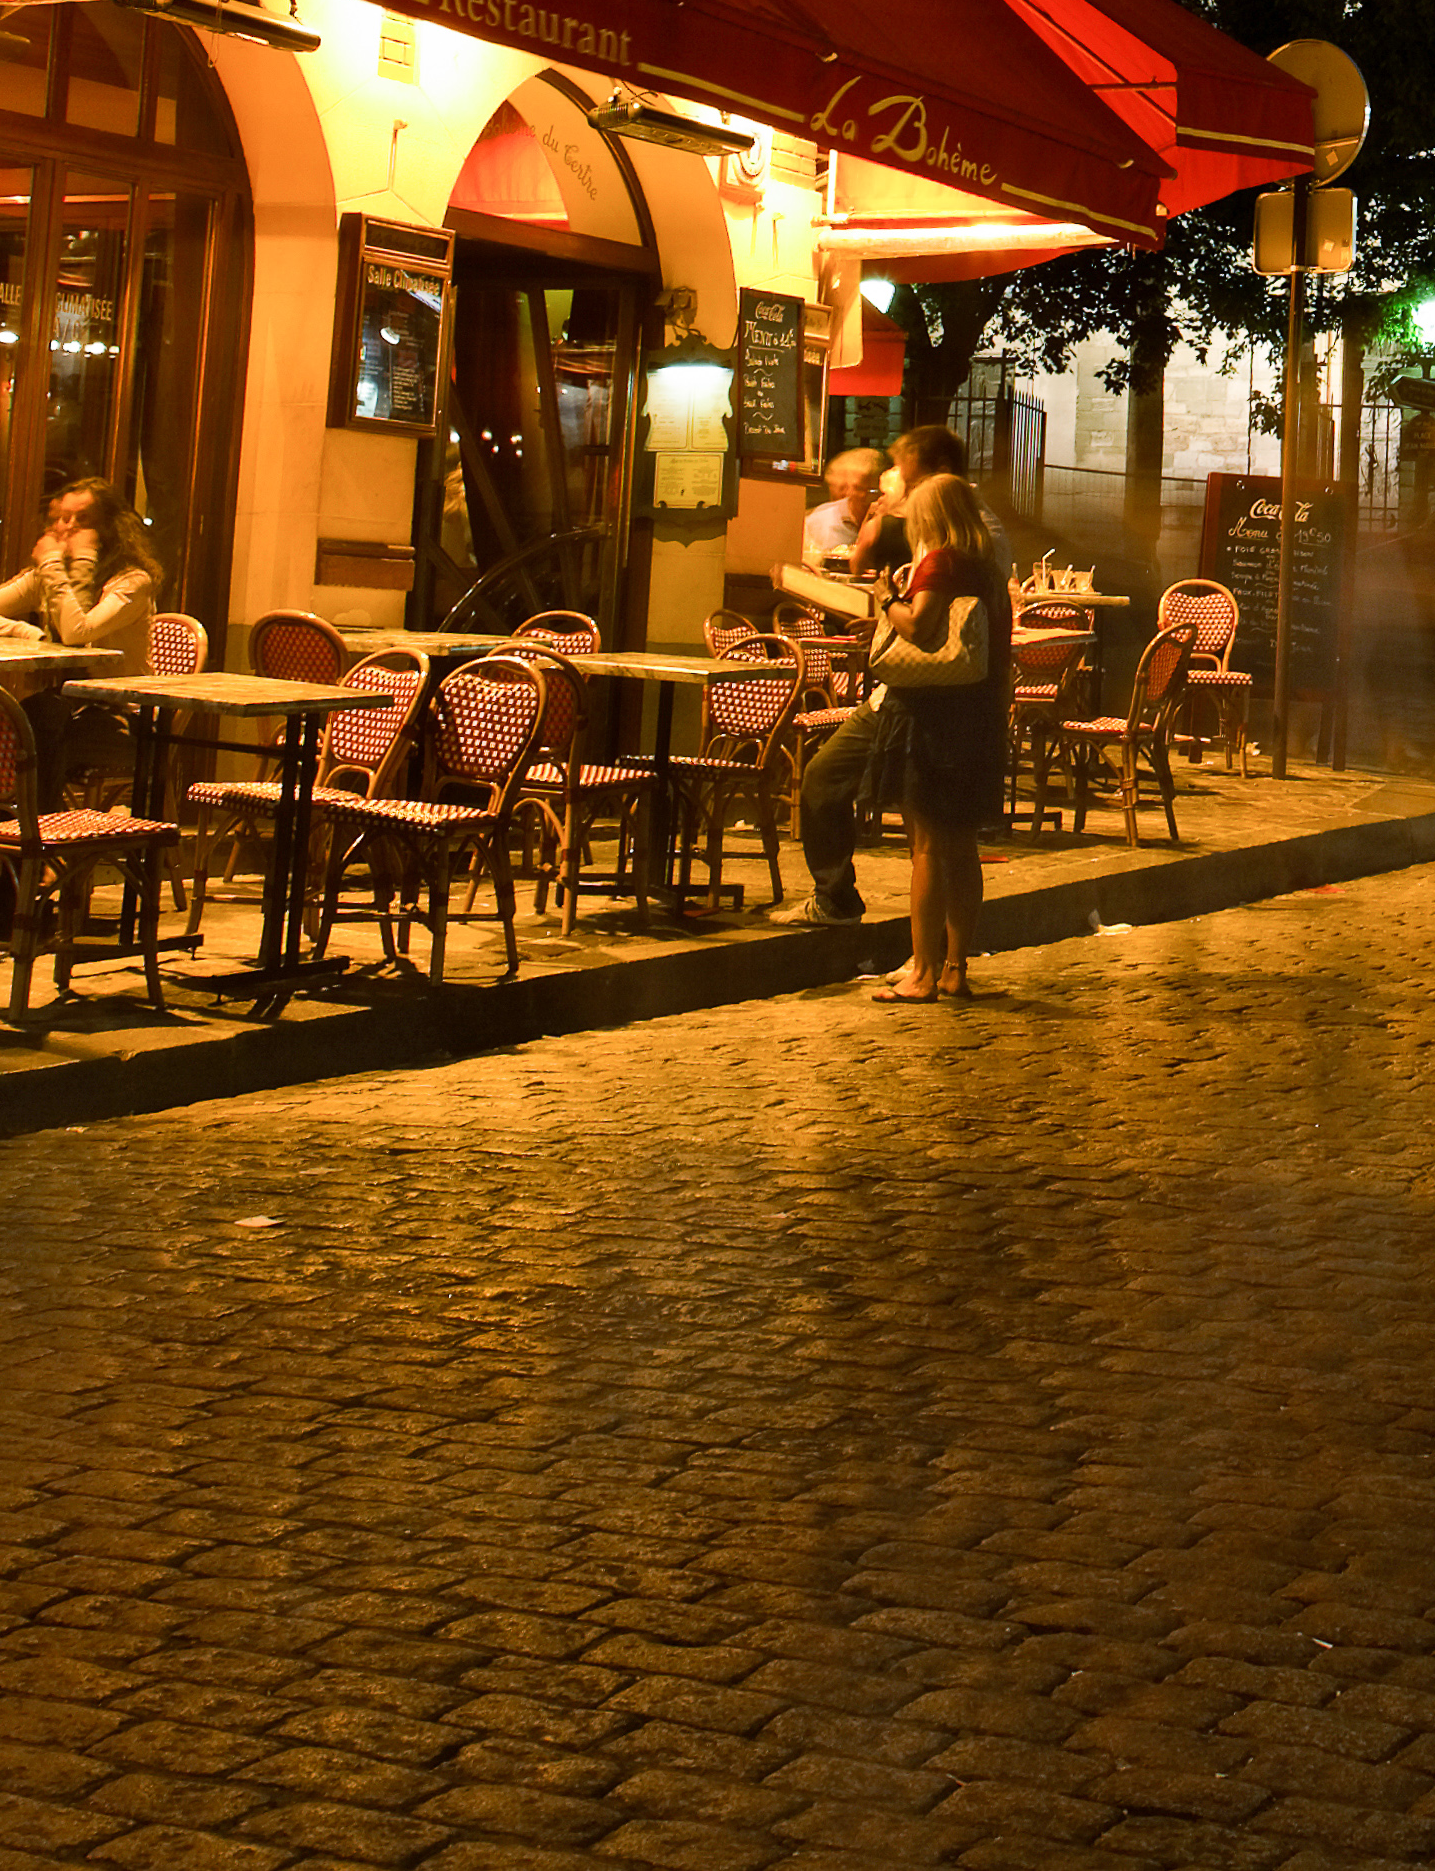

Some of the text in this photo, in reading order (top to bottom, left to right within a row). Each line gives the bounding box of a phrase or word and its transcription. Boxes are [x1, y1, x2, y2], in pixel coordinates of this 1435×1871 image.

[542, 125, 559, 153] du
[810, 74, 1000, 189] La Bohème
[368, 265, 391, 288] Salle
